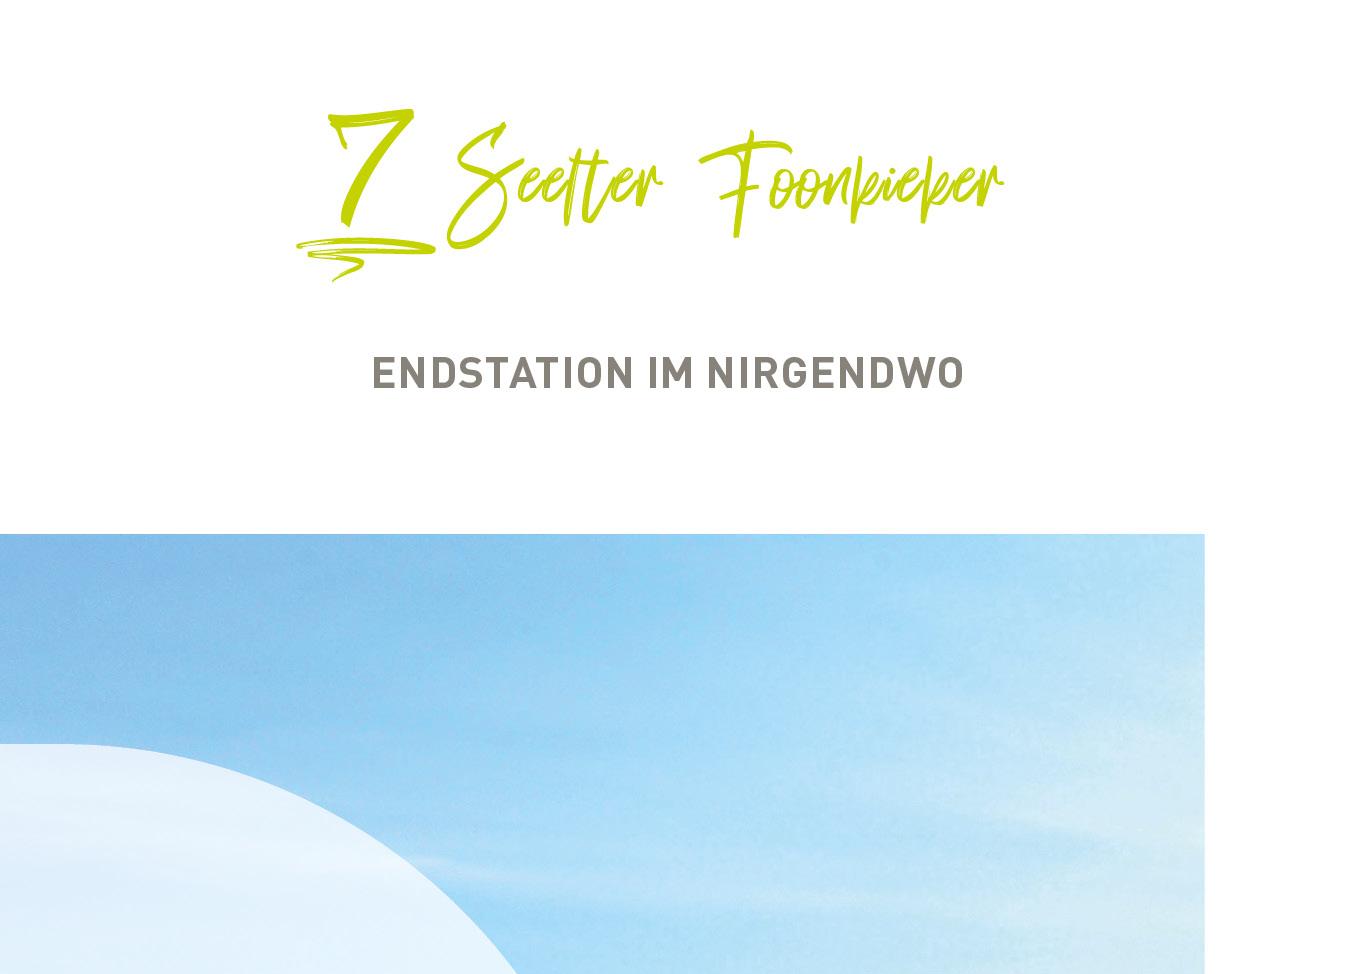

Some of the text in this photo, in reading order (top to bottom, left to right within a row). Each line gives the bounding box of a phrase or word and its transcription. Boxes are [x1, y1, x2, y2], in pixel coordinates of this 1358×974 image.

[327, 108, 1004, 249] 7 Seelter Foonkieker
[374, 357, 962, 388] ENDSTATION IM NIRGENDWO
